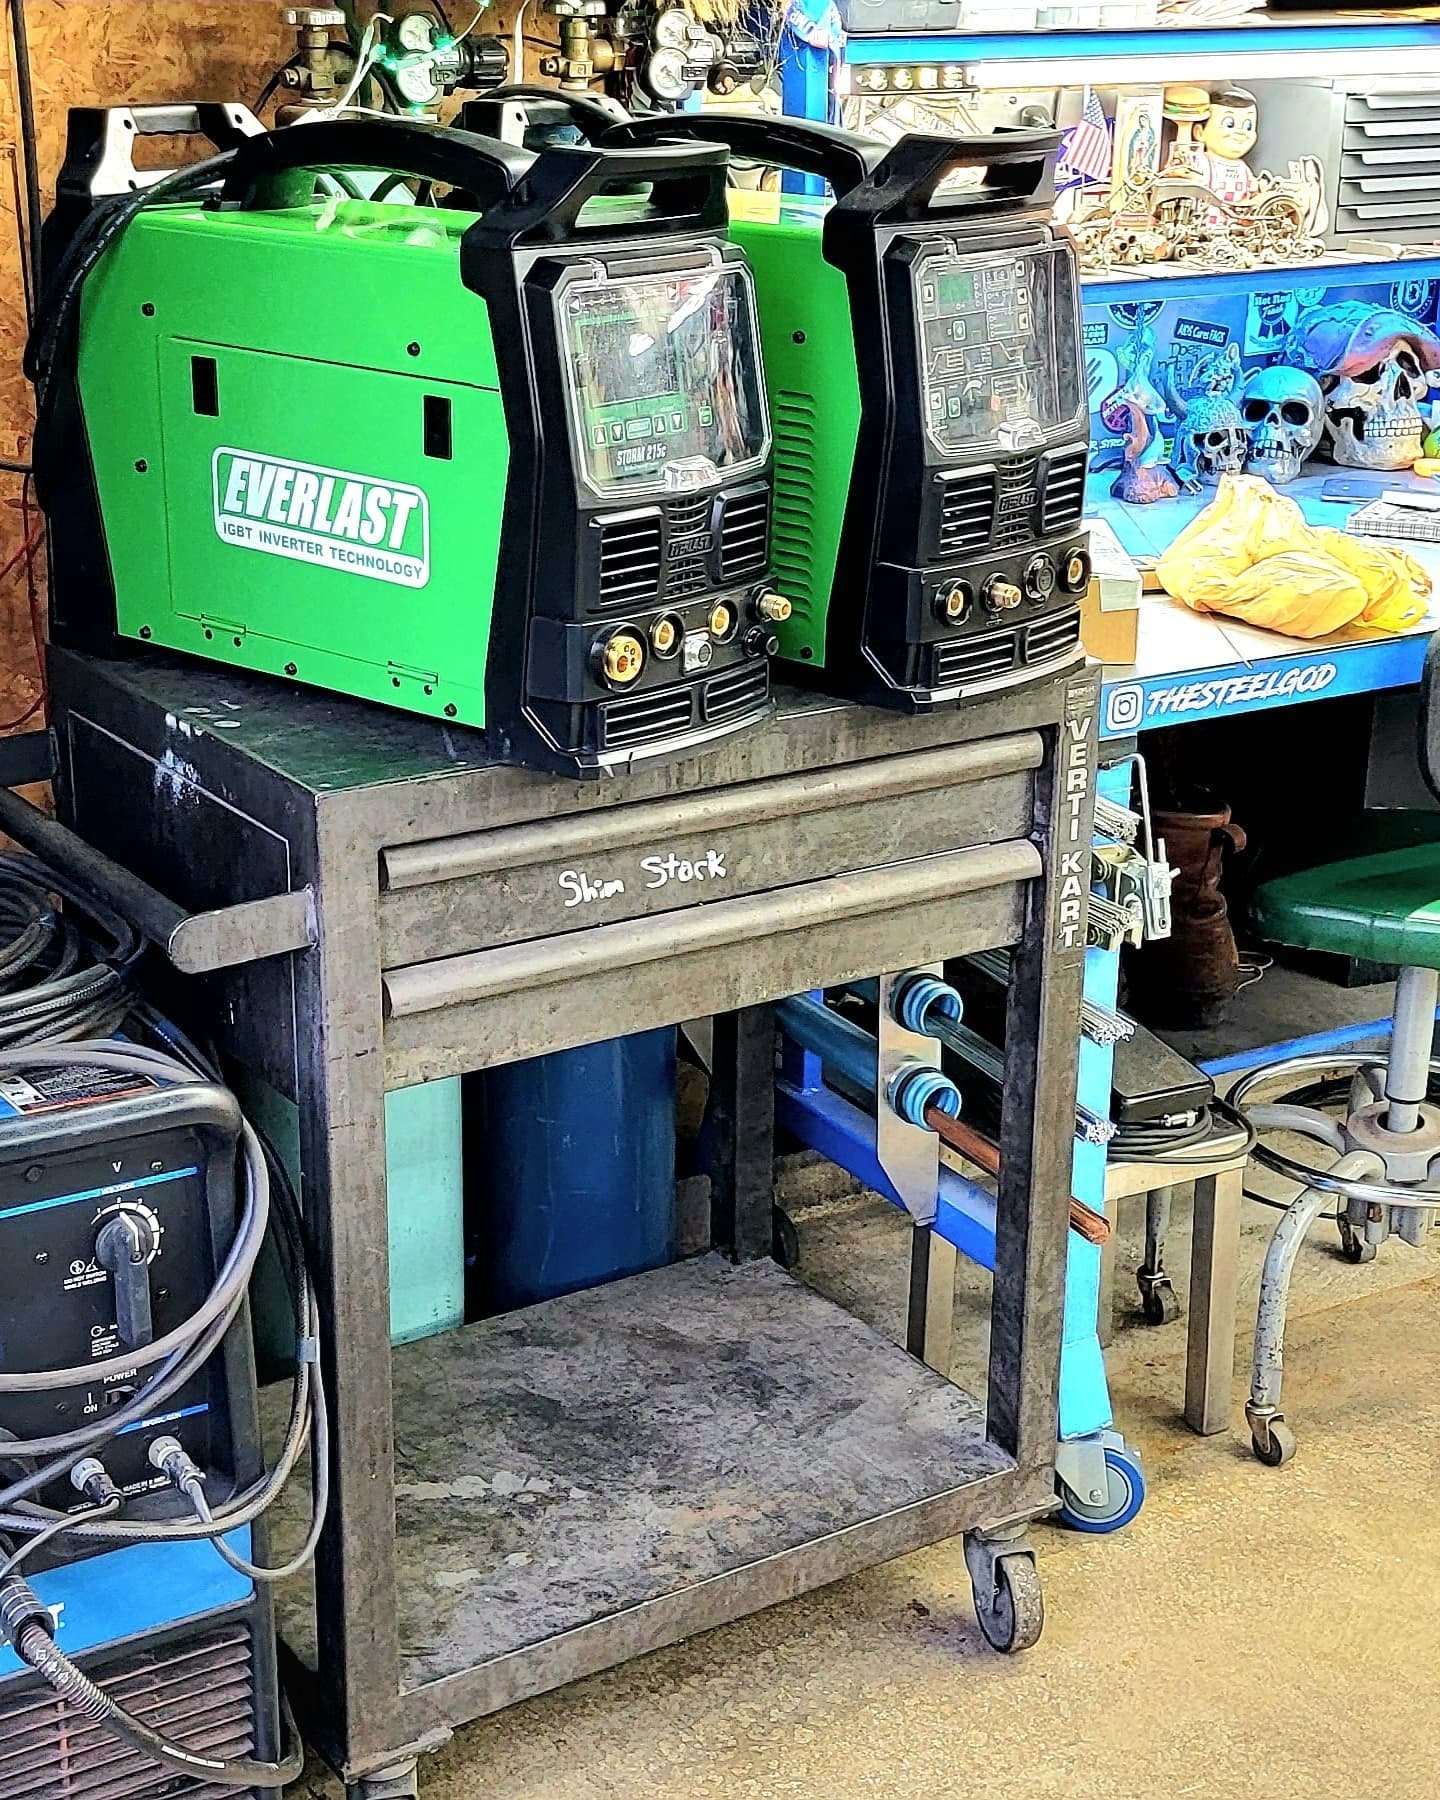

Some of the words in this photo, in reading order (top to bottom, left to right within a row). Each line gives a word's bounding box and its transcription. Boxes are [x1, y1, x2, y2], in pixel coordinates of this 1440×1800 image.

[616, 446, 645, 466] STORM
[646, 442, 667, 460] 215c
[223, 457, 419, 550] EVERLAST
[223, 522, 252, 540] IGBT
[259, 530, 323, 557] INVERTER
[329, 546, 423, 580] TECHNOLOGY
[1147, 662, 1337, 716] THESTEELGOD
[1066, 717, 1092, 841] VERTI
[558, 870, 625, 908] Shim
[112, 1161, 122, 1173] V
[103, 1368, 137, 1384] POWER
[83, 1404, 98, 1414] ON
